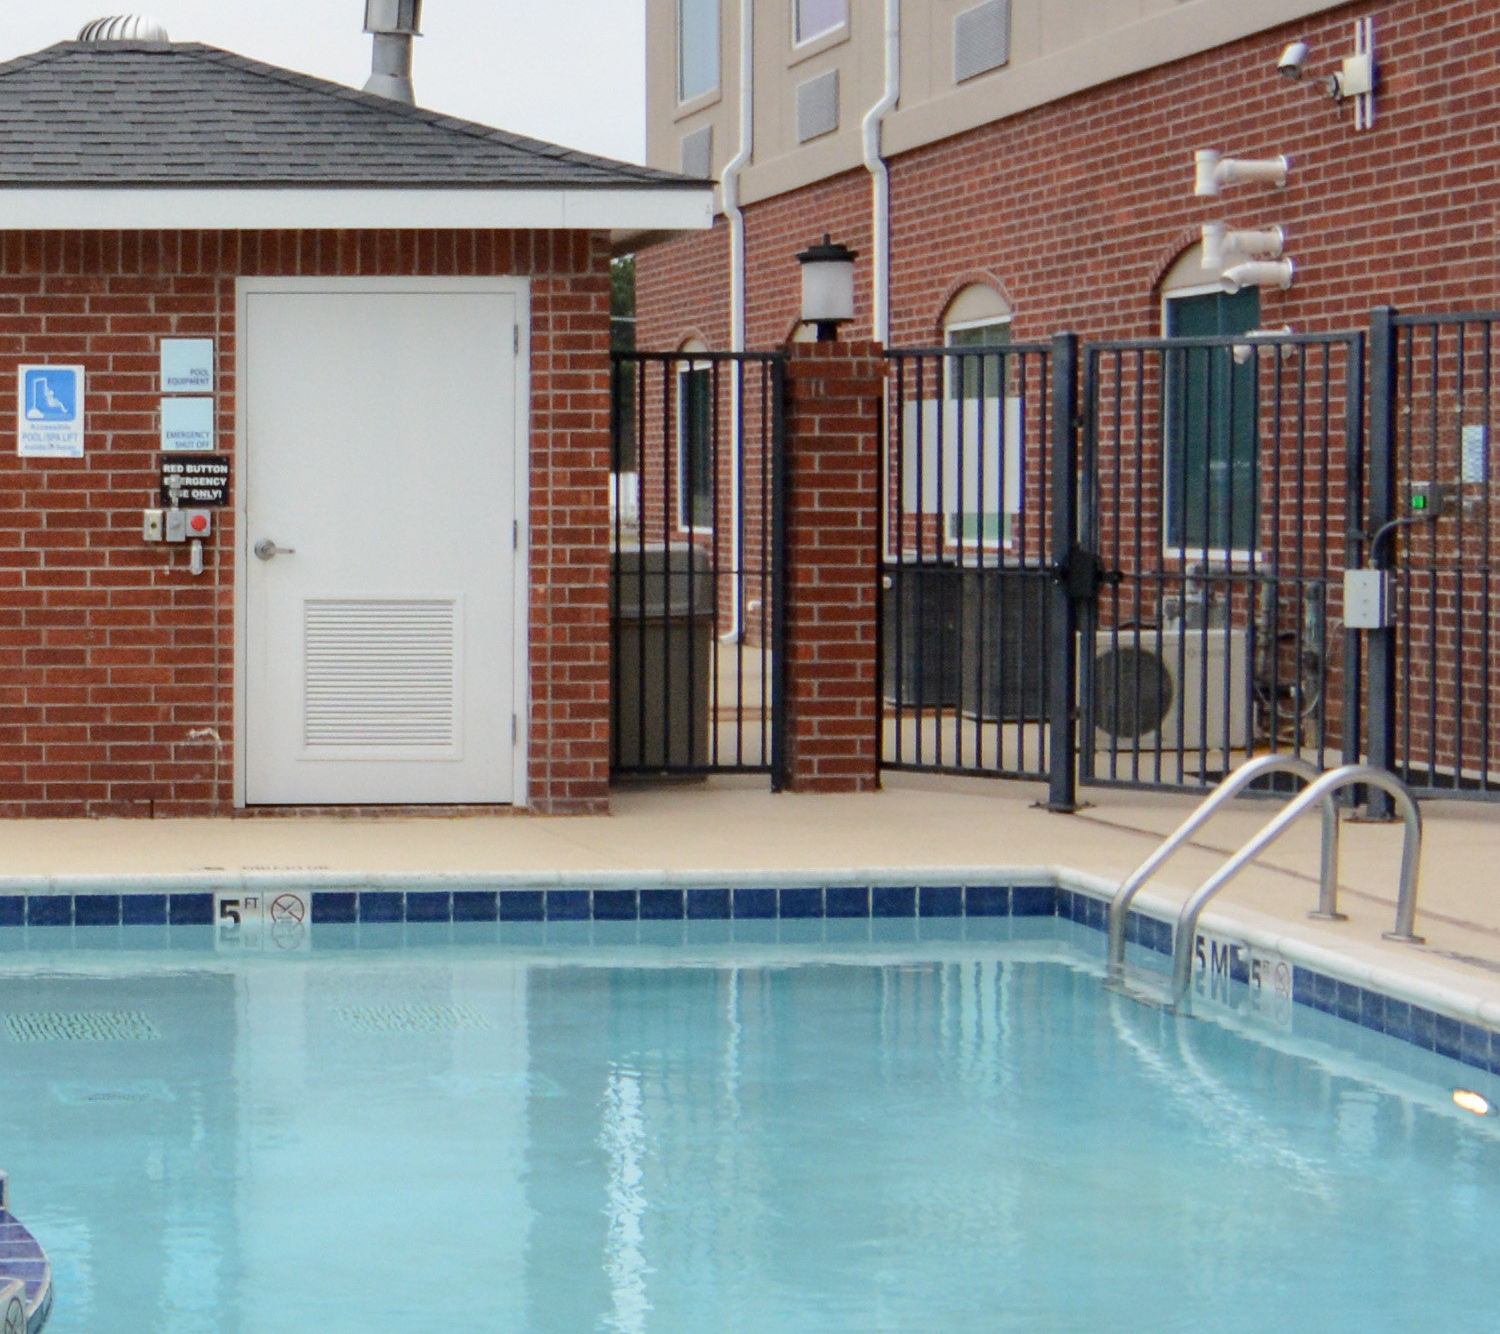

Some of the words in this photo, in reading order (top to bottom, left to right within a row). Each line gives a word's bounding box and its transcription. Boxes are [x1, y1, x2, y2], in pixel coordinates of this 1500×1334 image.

[189, 369, 210, 377] POOL
[167, 377, 210, 385] EQUIPMENT
[162, 464, 184, 474] RED
[185, 464, 229, 474] BUTTON
[163, 476, 228, 487] EERGENCY
[191, 489, 223, 500] ONLY!
[244, 897, 259, 910] FT
